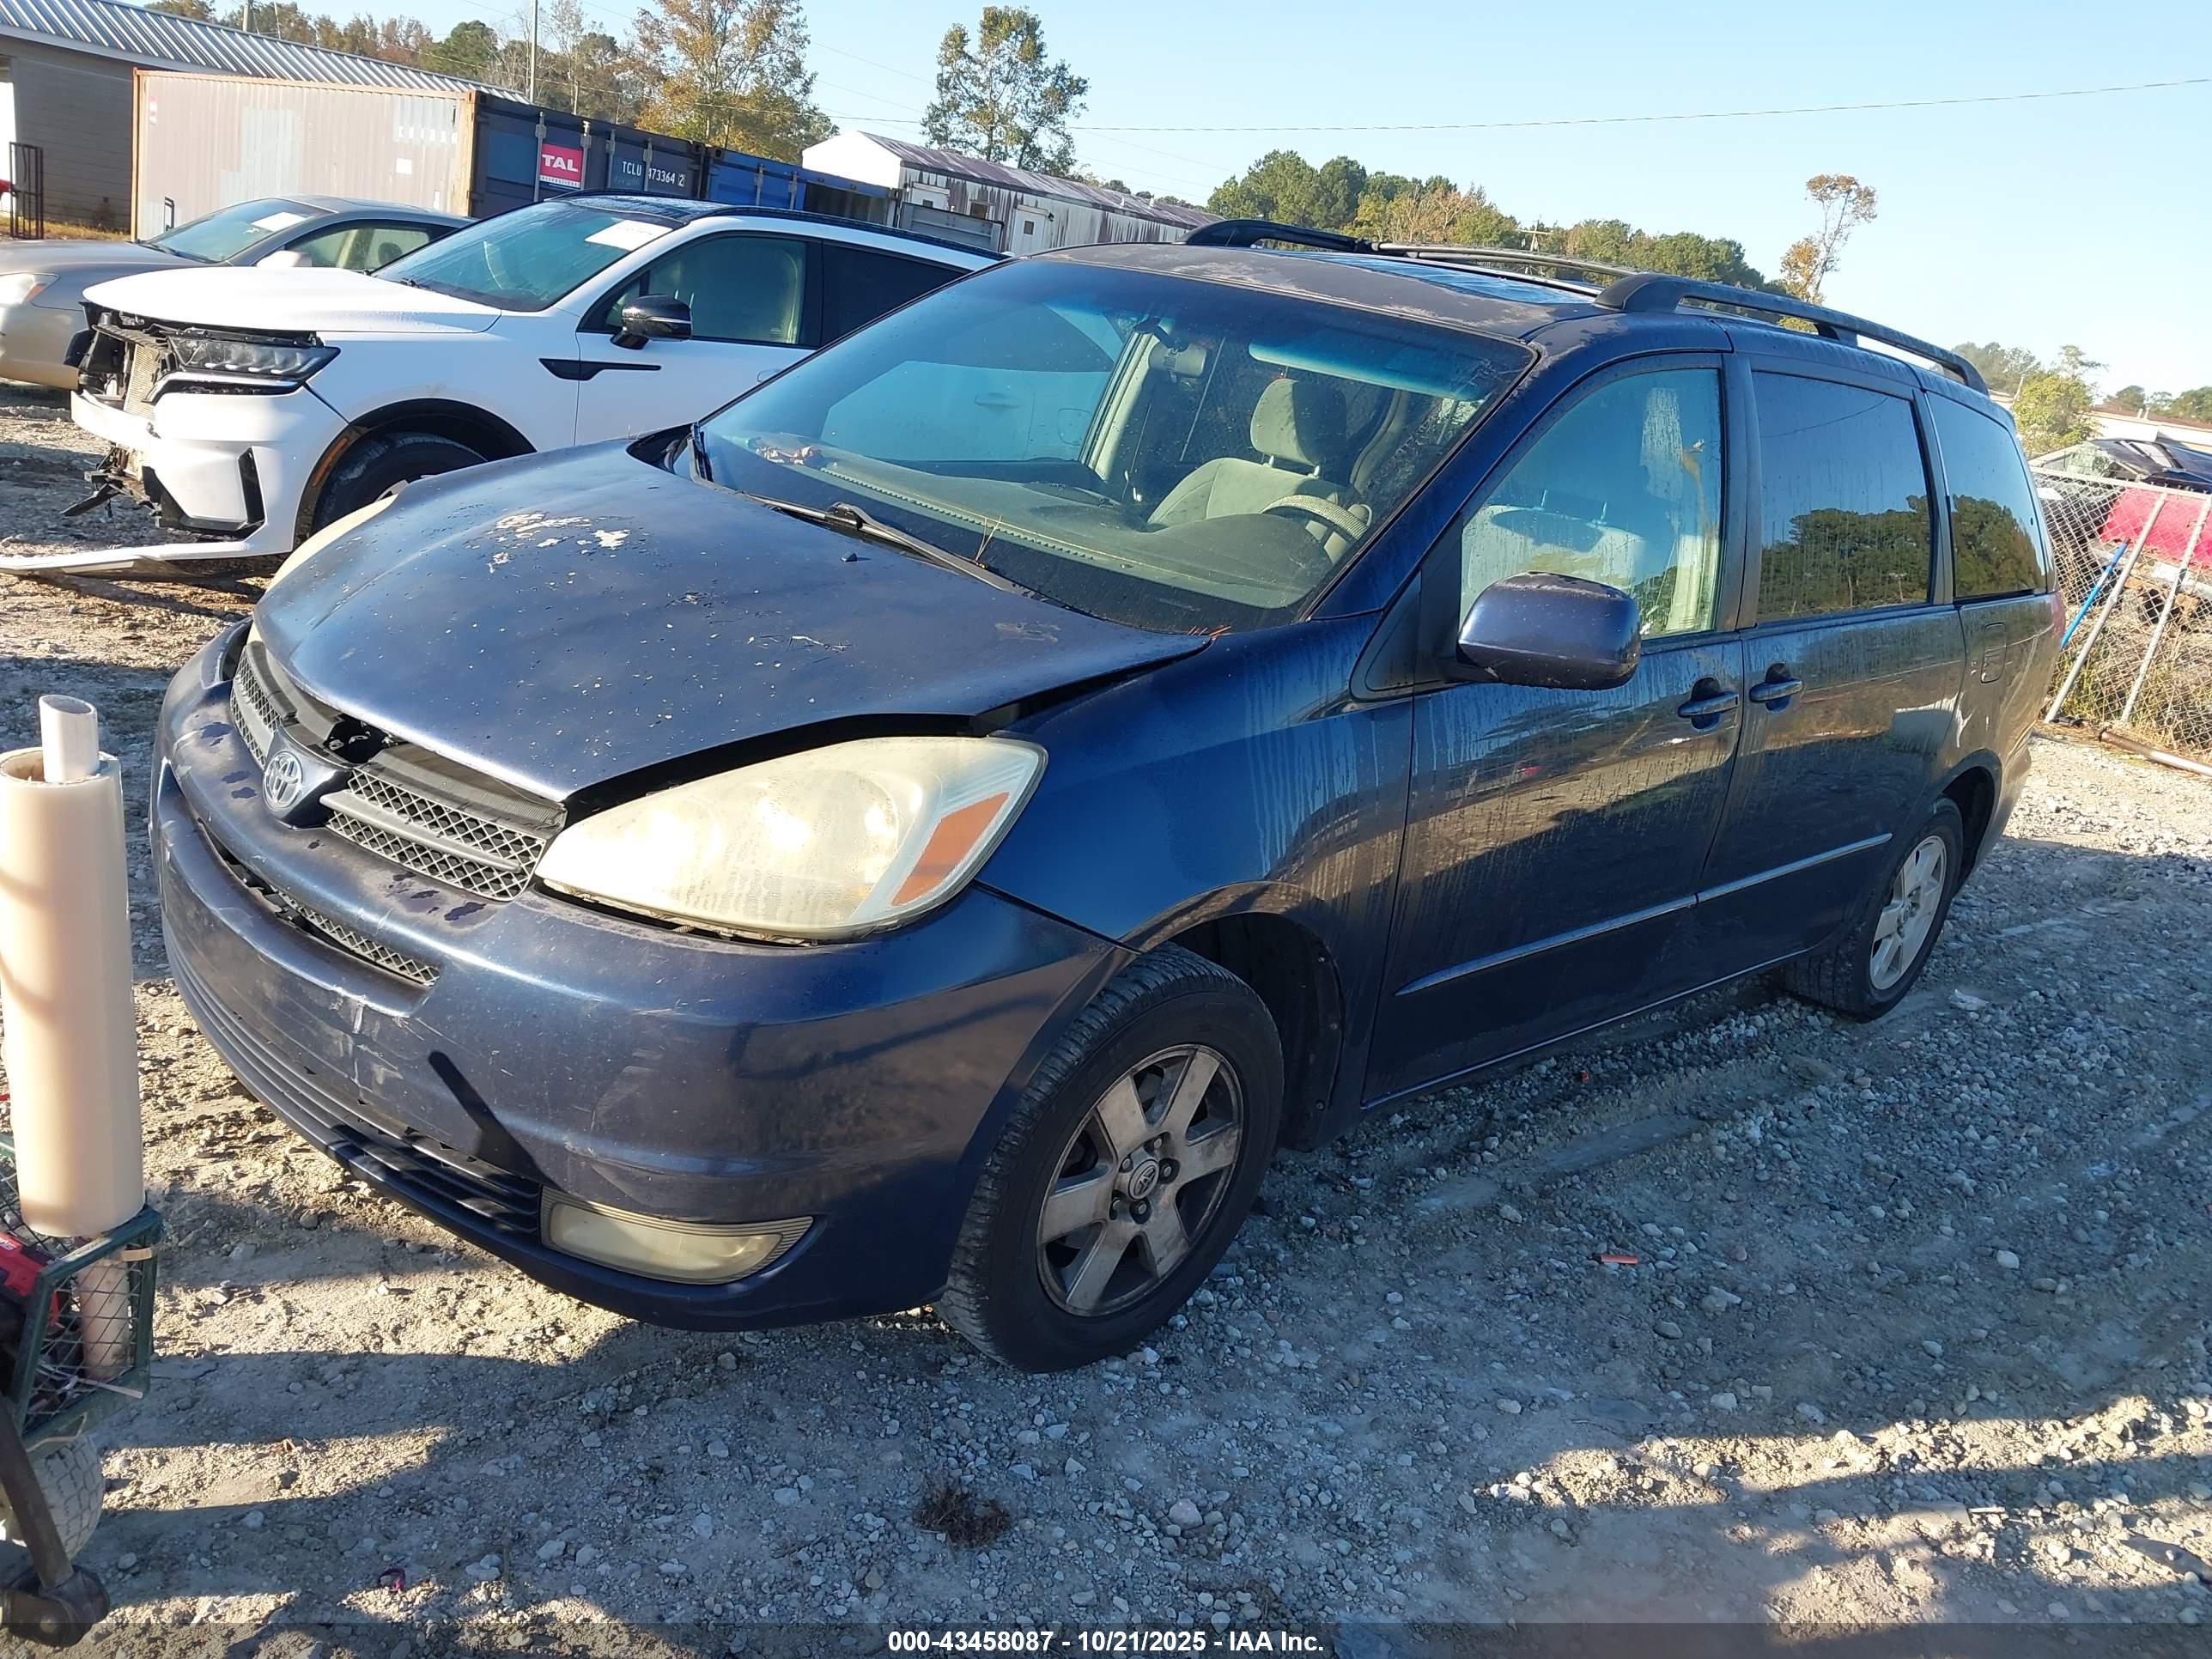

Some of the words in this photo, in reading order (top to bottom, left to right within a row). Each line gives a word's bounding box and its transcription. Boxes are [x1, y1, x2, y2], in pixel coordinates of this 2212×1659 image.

[542, 154, 579, 173] TAL
[623, 161, 642, 177] TCLU
[678, 174, 685, 187] 2
